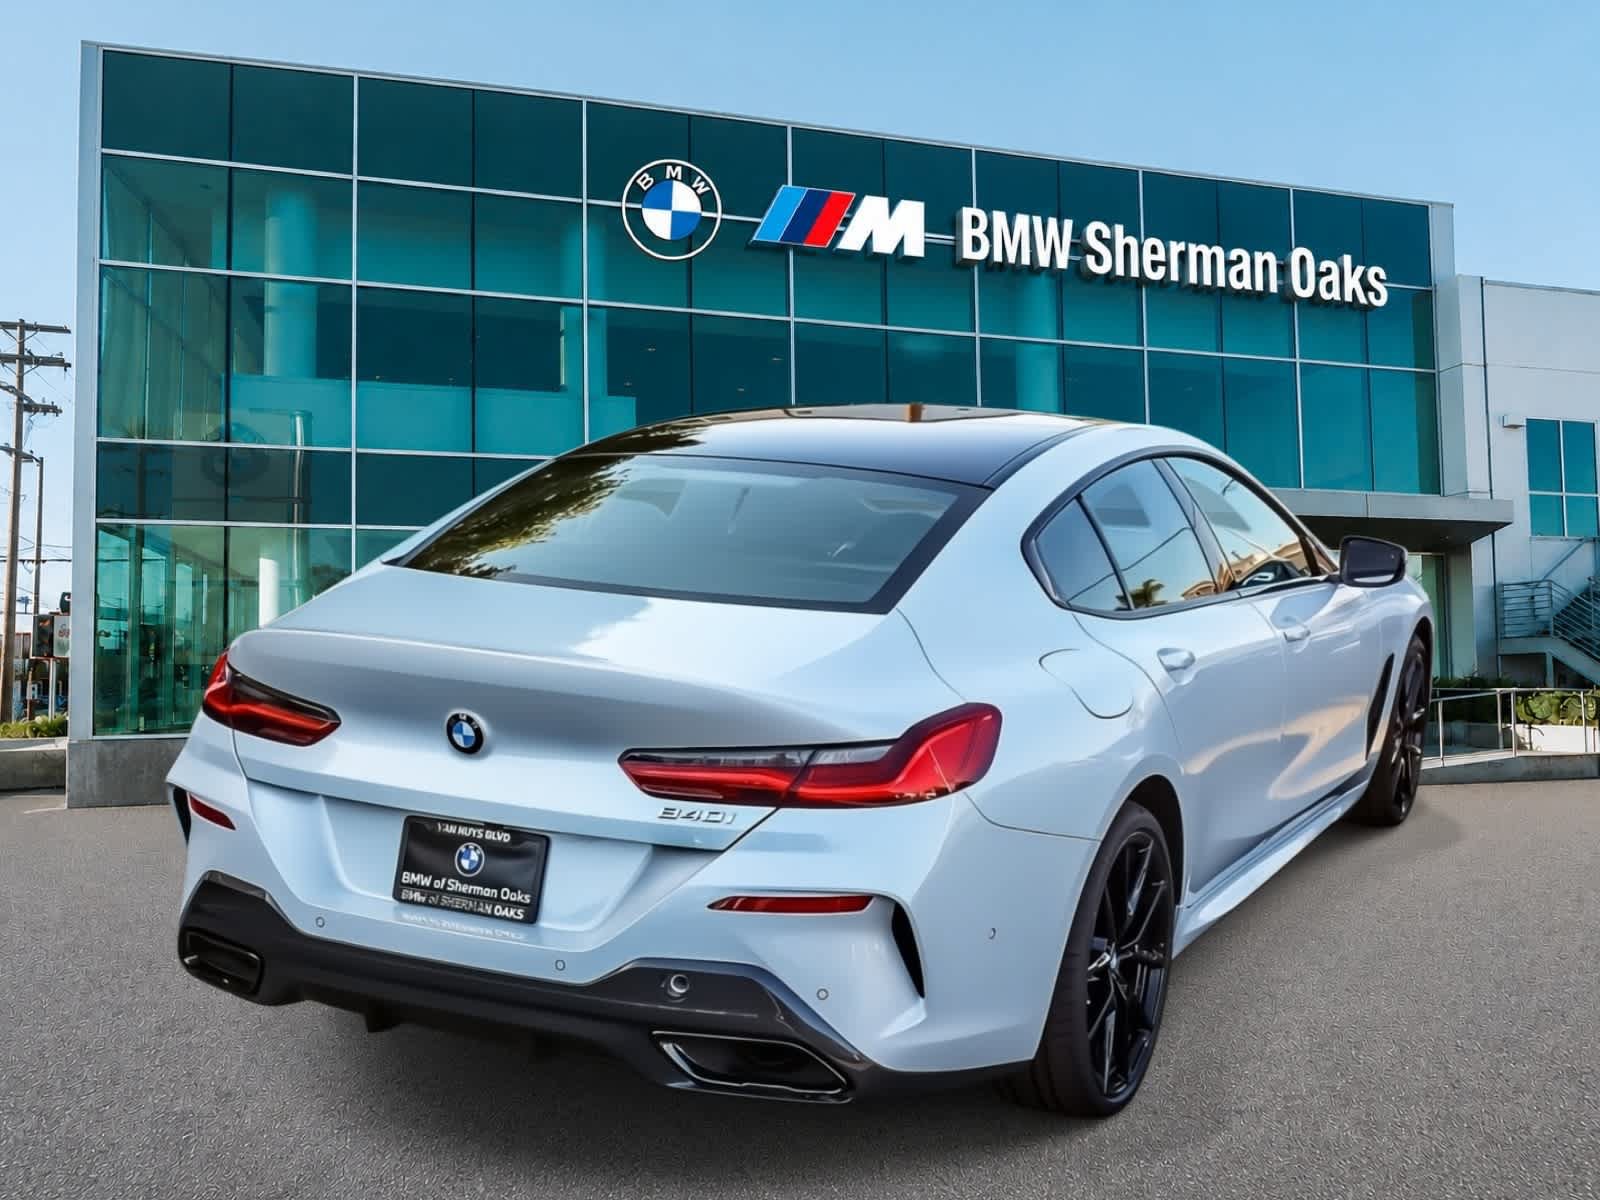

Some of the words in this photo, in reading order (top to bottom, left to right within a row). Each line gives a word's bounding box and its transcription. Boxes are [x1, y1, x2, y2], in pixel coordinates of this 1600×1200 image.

[636, 165, 711, 196] BMW
[960, 206, 1073, 270] BMW
[1084, 220, 1278, 293] Sherman
[1289, 247, 1388, 307] Oaks
[484, 829, 511, 843] BLVD
[401, 871, 432, 887] BMW
[433, 878, 446, 889] of
[446, 878, 498, 899] Sherman
[500, 887, 531, 904] Oaks
[493, 904, 524, 920] OAKS
